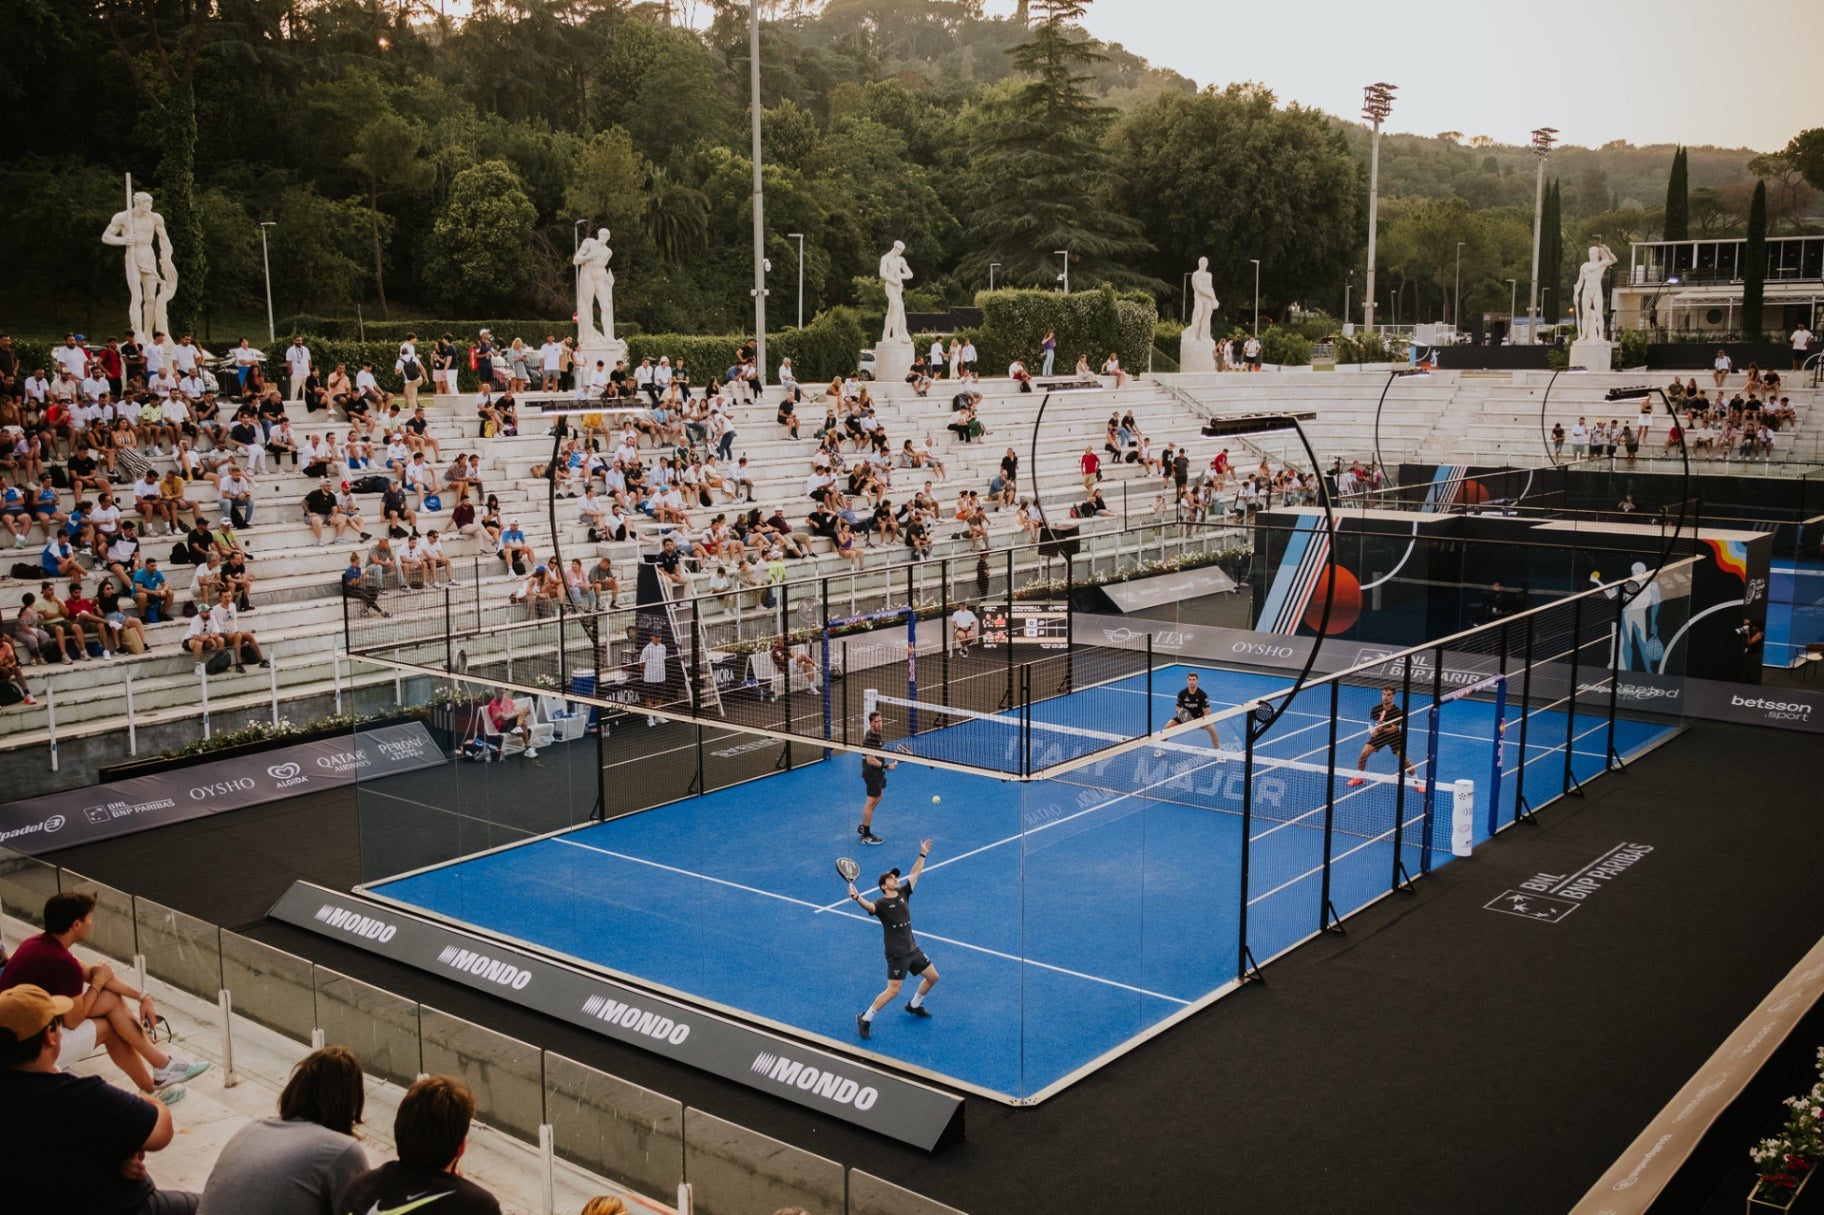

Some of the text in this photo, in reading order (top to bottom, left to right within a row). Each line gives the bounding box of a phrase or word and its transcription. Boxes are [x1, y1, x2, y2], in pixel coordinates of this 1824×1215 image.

[1231, 641, 1293, 658] OYSHO
[1730, 695, 1812, 713] betsson
[1764, 711, 1808, 722] .sport
[377, 738, 424, 754] PERONI
[316, 750, 366, 769] QATAR
[189, 777, 255, 800] OYSHO
[277, 776, 307, 788] ALGIDA
[107, 801, 128, 810] BNL
[111, 800, 176, 818] BNP PARIBAS
[1557, 842, 1655, 900] BNP PARIBAS
[1519, 872, 1568, 892] BNL
[326, 906, 398, 944] MONDO
[450, 949, 533, 990] MONDO
[598, 999, 691, 1045] MONDO
[768, 1056, 879, 1111] MONDO
